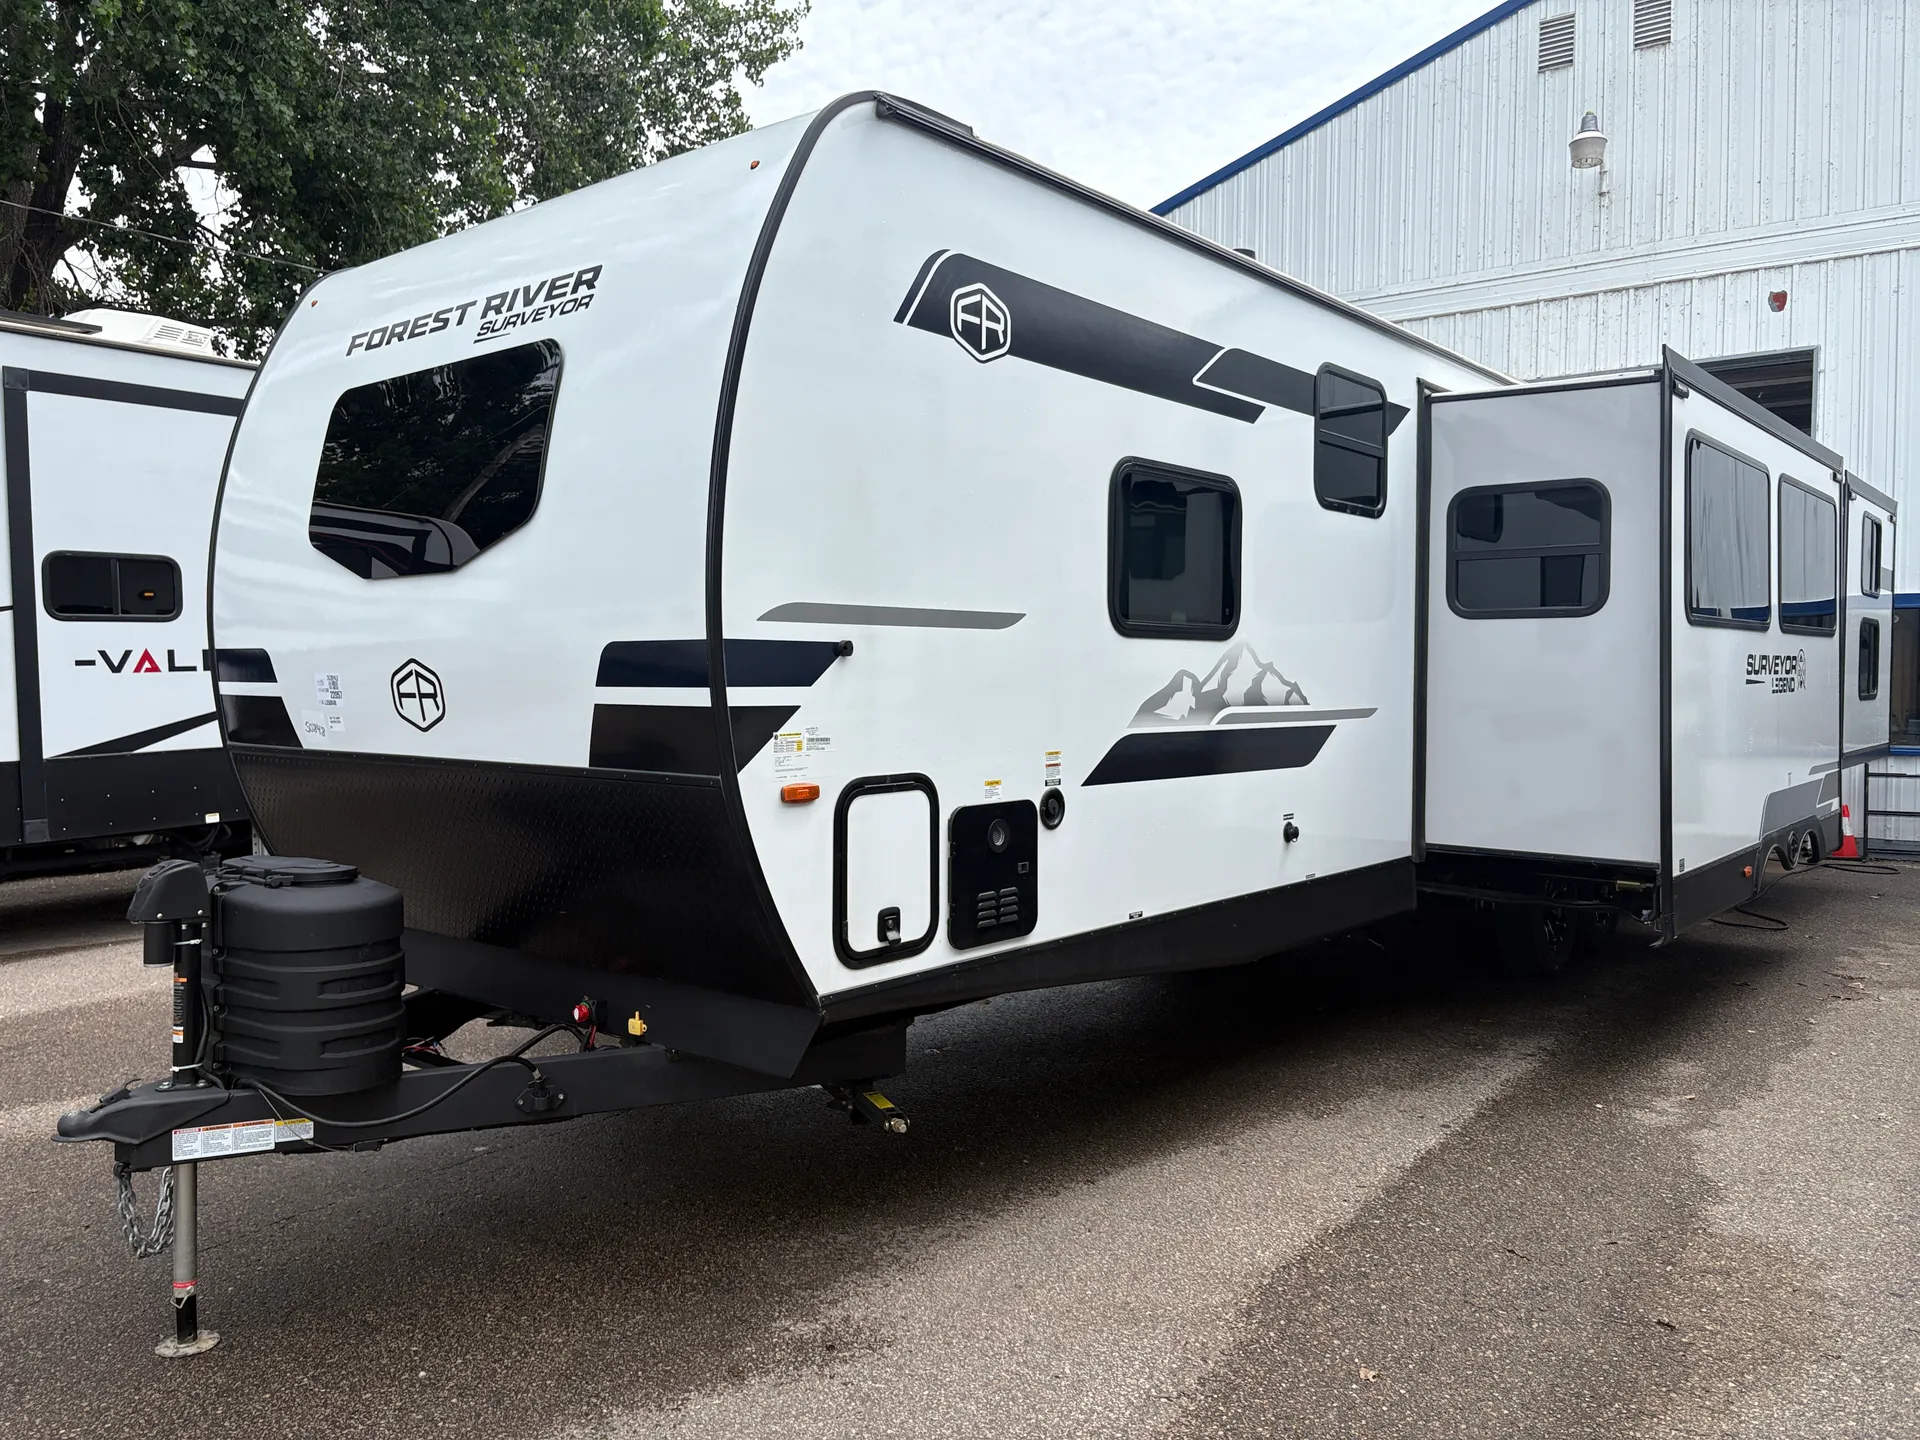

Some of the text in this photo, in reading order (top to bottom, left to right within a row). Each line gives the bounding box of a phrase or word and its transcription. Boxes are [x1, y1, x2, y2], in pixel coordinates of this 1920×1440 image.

[345, 264, 604, 357] FOREST RIVER
[476, 292, 595, 338] SURVEYOR
[1746, 654, 1798, 676] SURVEYOR
[1771, 677, 1796, 694] LEGEND
